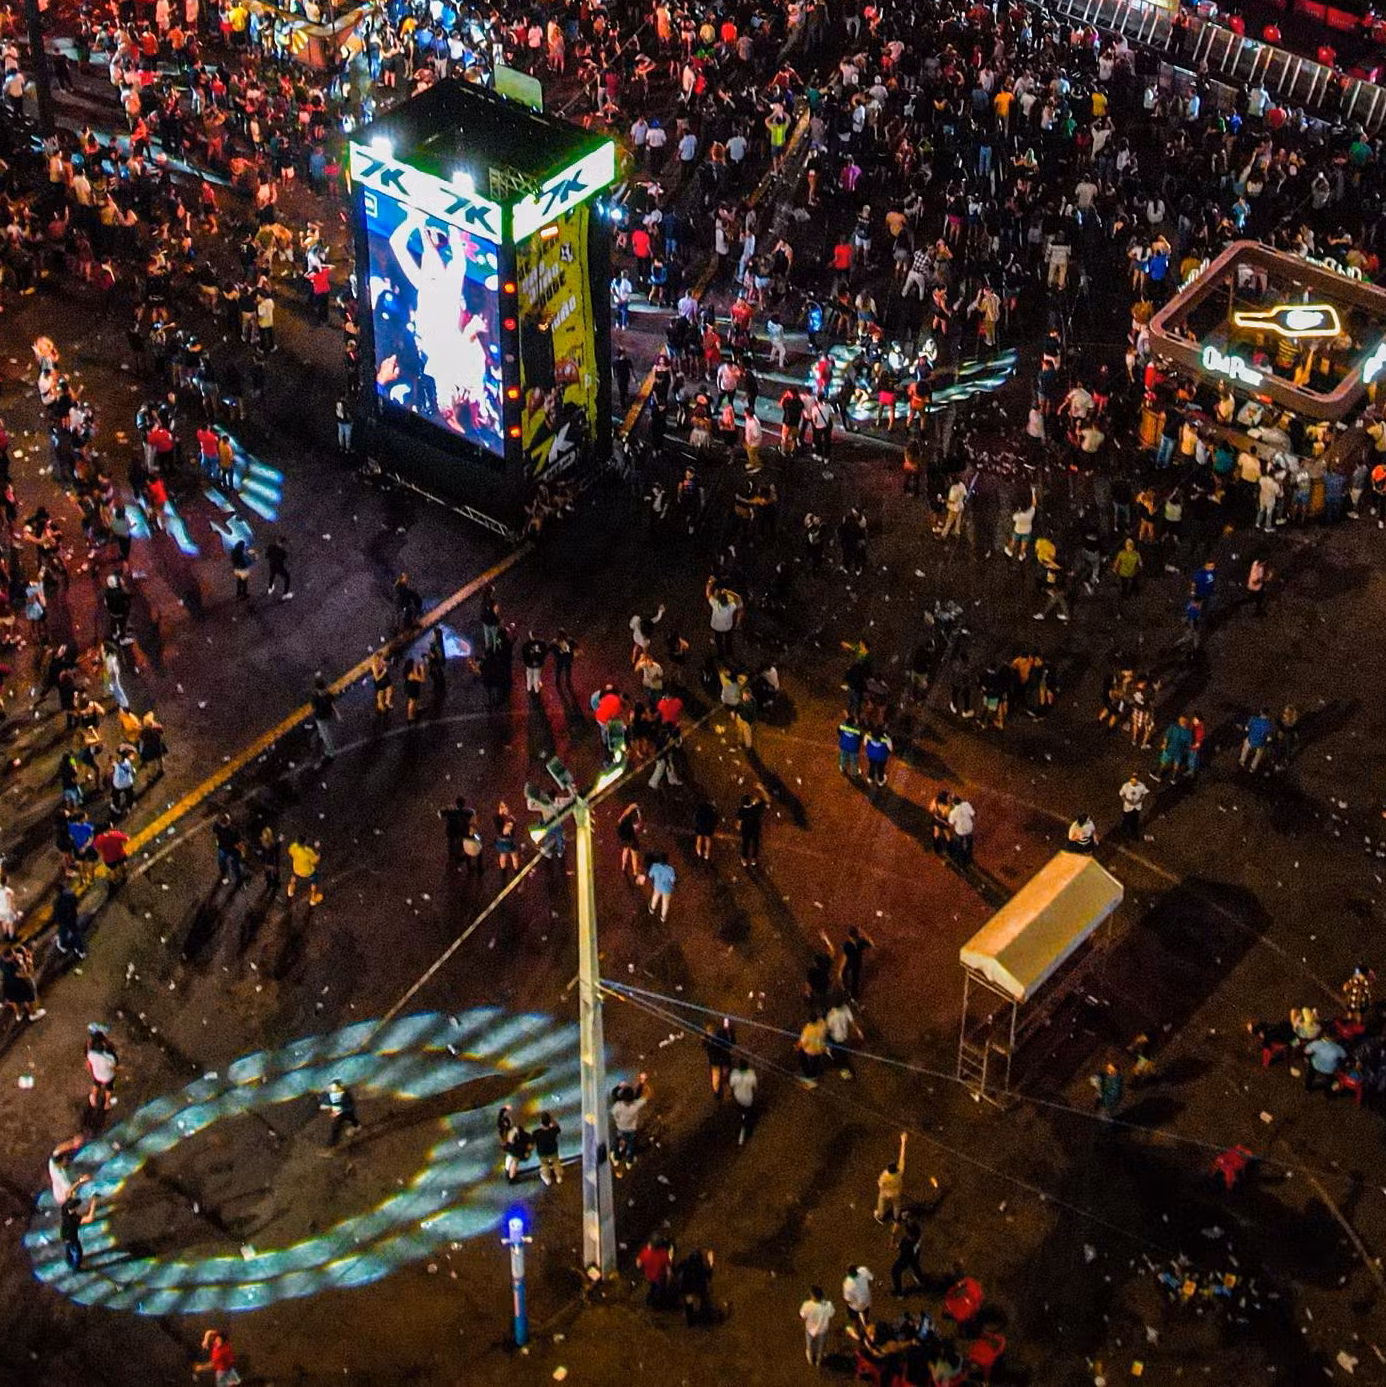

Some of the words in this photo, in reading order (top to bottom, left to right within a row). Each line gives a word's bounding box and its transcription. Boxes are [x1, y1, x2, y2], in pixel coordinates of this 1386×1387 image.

[357, 150, 409, 196] 7K
[540, 168, 589, 215] 7K
[444, 187, 496, 234] 7K
[531, 422, 575, 475] 7K
